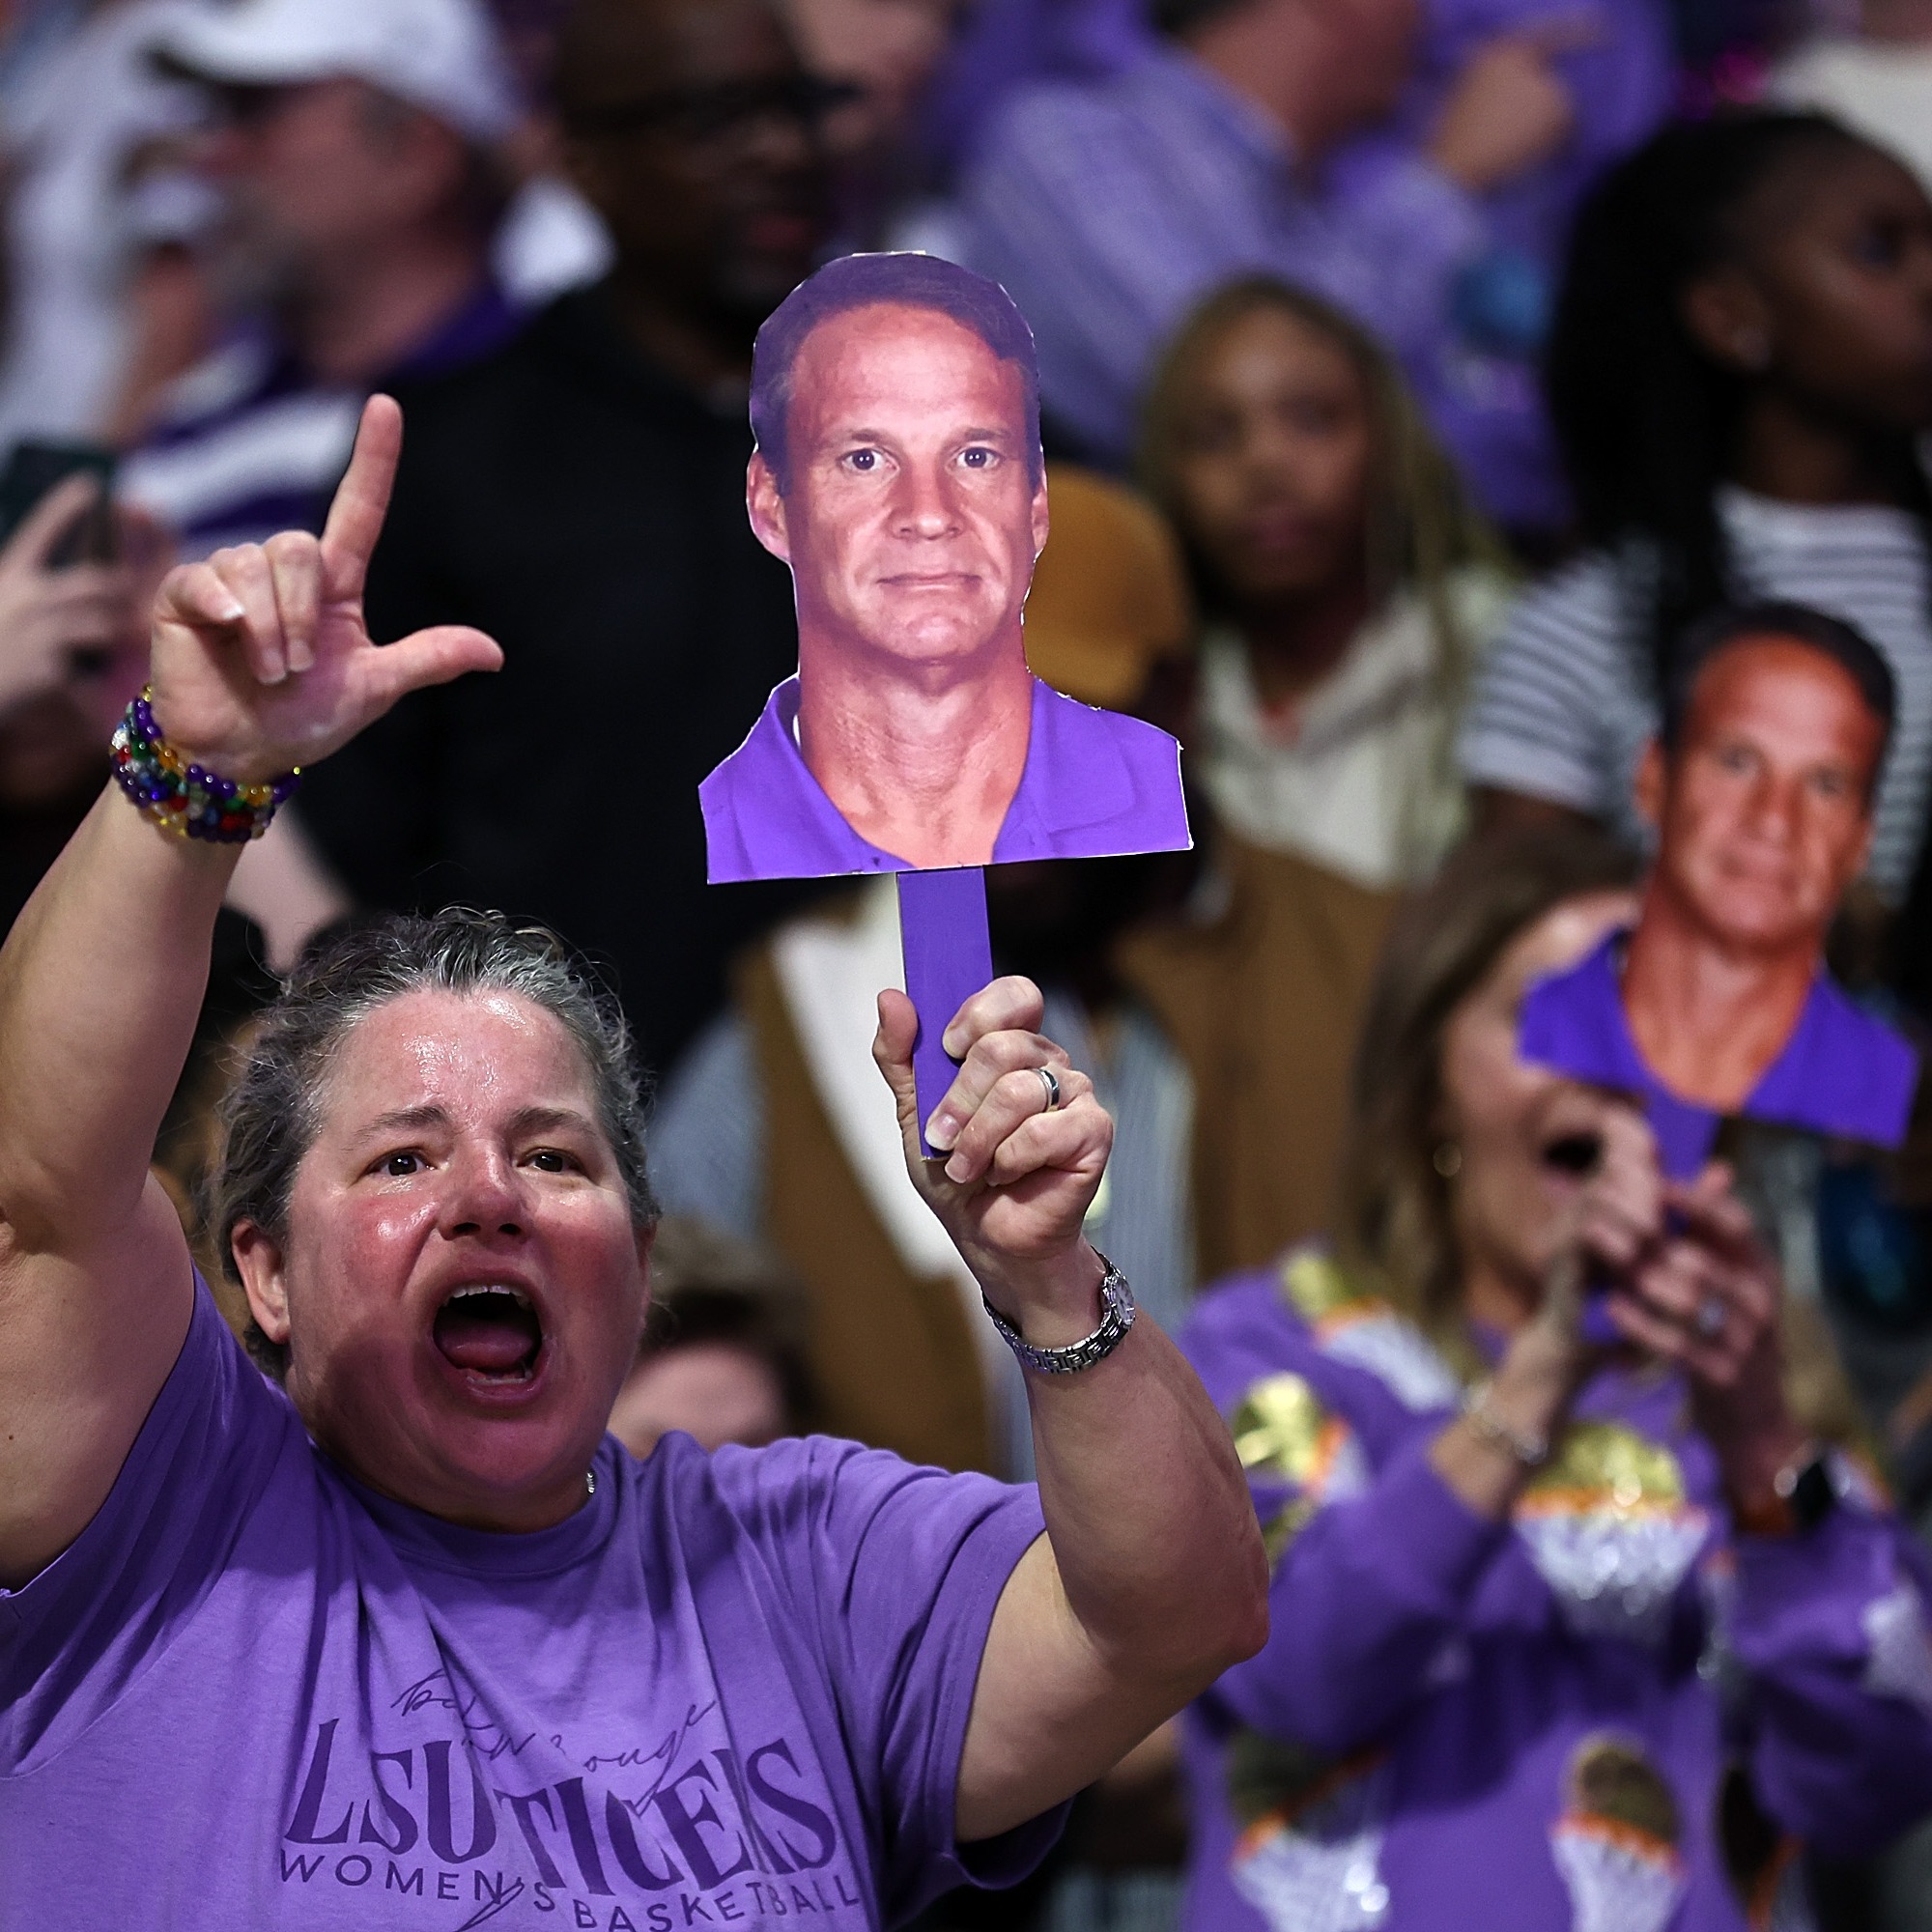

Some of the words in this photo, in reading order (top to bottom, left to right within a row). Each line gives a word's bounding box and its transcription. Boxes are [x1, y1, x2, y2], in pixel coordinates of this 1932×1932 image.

[283, 1718, 497, 1864] LSU
[280, 1848, 555, 1912] WOMEN'S
[573, 1874, 860, 1932] BASKETBALL
